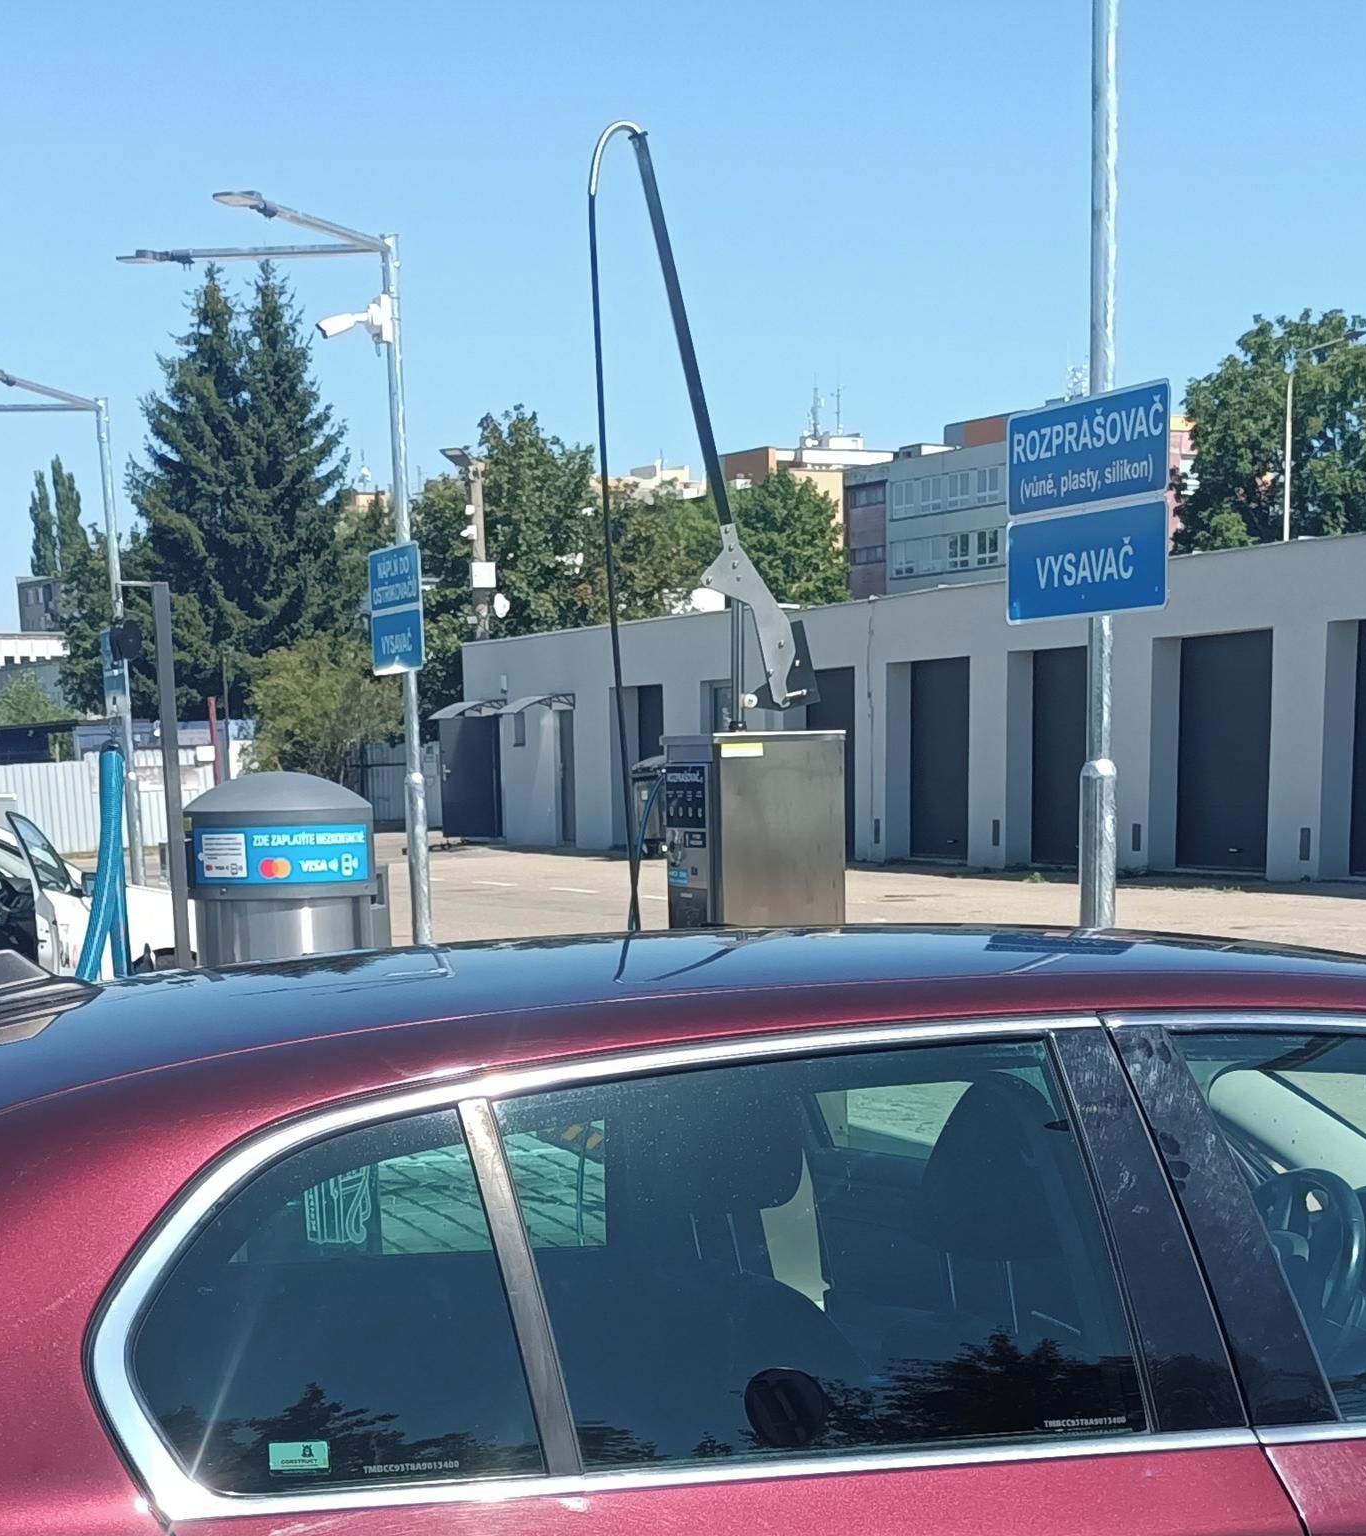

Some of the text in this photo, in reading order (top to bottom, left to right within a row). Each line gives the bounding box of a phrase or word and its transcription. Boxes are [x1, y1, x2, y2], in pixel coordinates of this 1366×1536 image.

[1013, 394, 1165, 464] ROZPRAŠOVAČ
[1020, 454, 1153, 504] (vůně, plasty, silikon)
[399, 555, 410, 575] DO
[1036, 536, 1134, 590] VYSAVAČ
[380, 627, 413, 656] VYSAVAČ
[252, 834, 271, 848] ZDE
